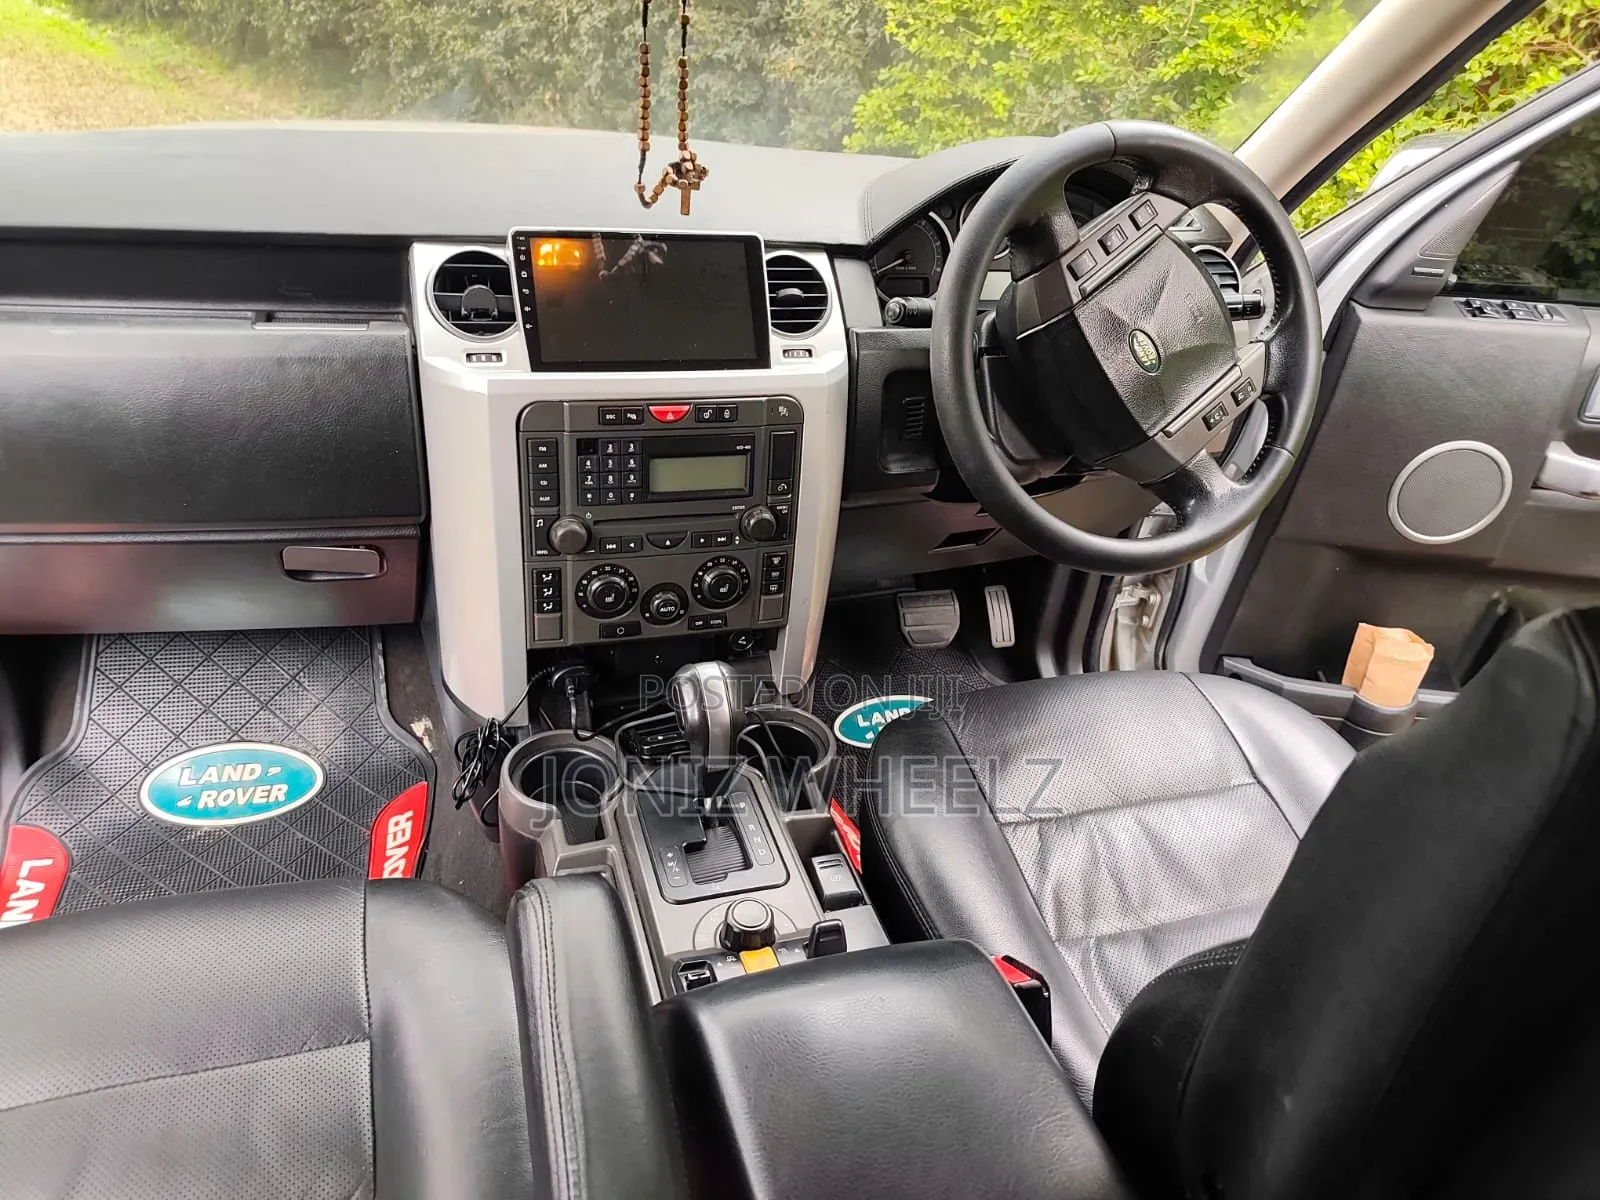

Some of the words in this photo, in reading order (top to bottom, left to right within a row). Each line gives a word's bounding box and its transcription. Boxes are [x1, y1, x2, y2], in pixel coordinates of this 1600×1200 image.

[178, 763, 263, 787] LAND
[197, 784, 289, 809] ROVER
[382, 810, 414, 879] OVER
[0, 858, 54, 929] LAN
